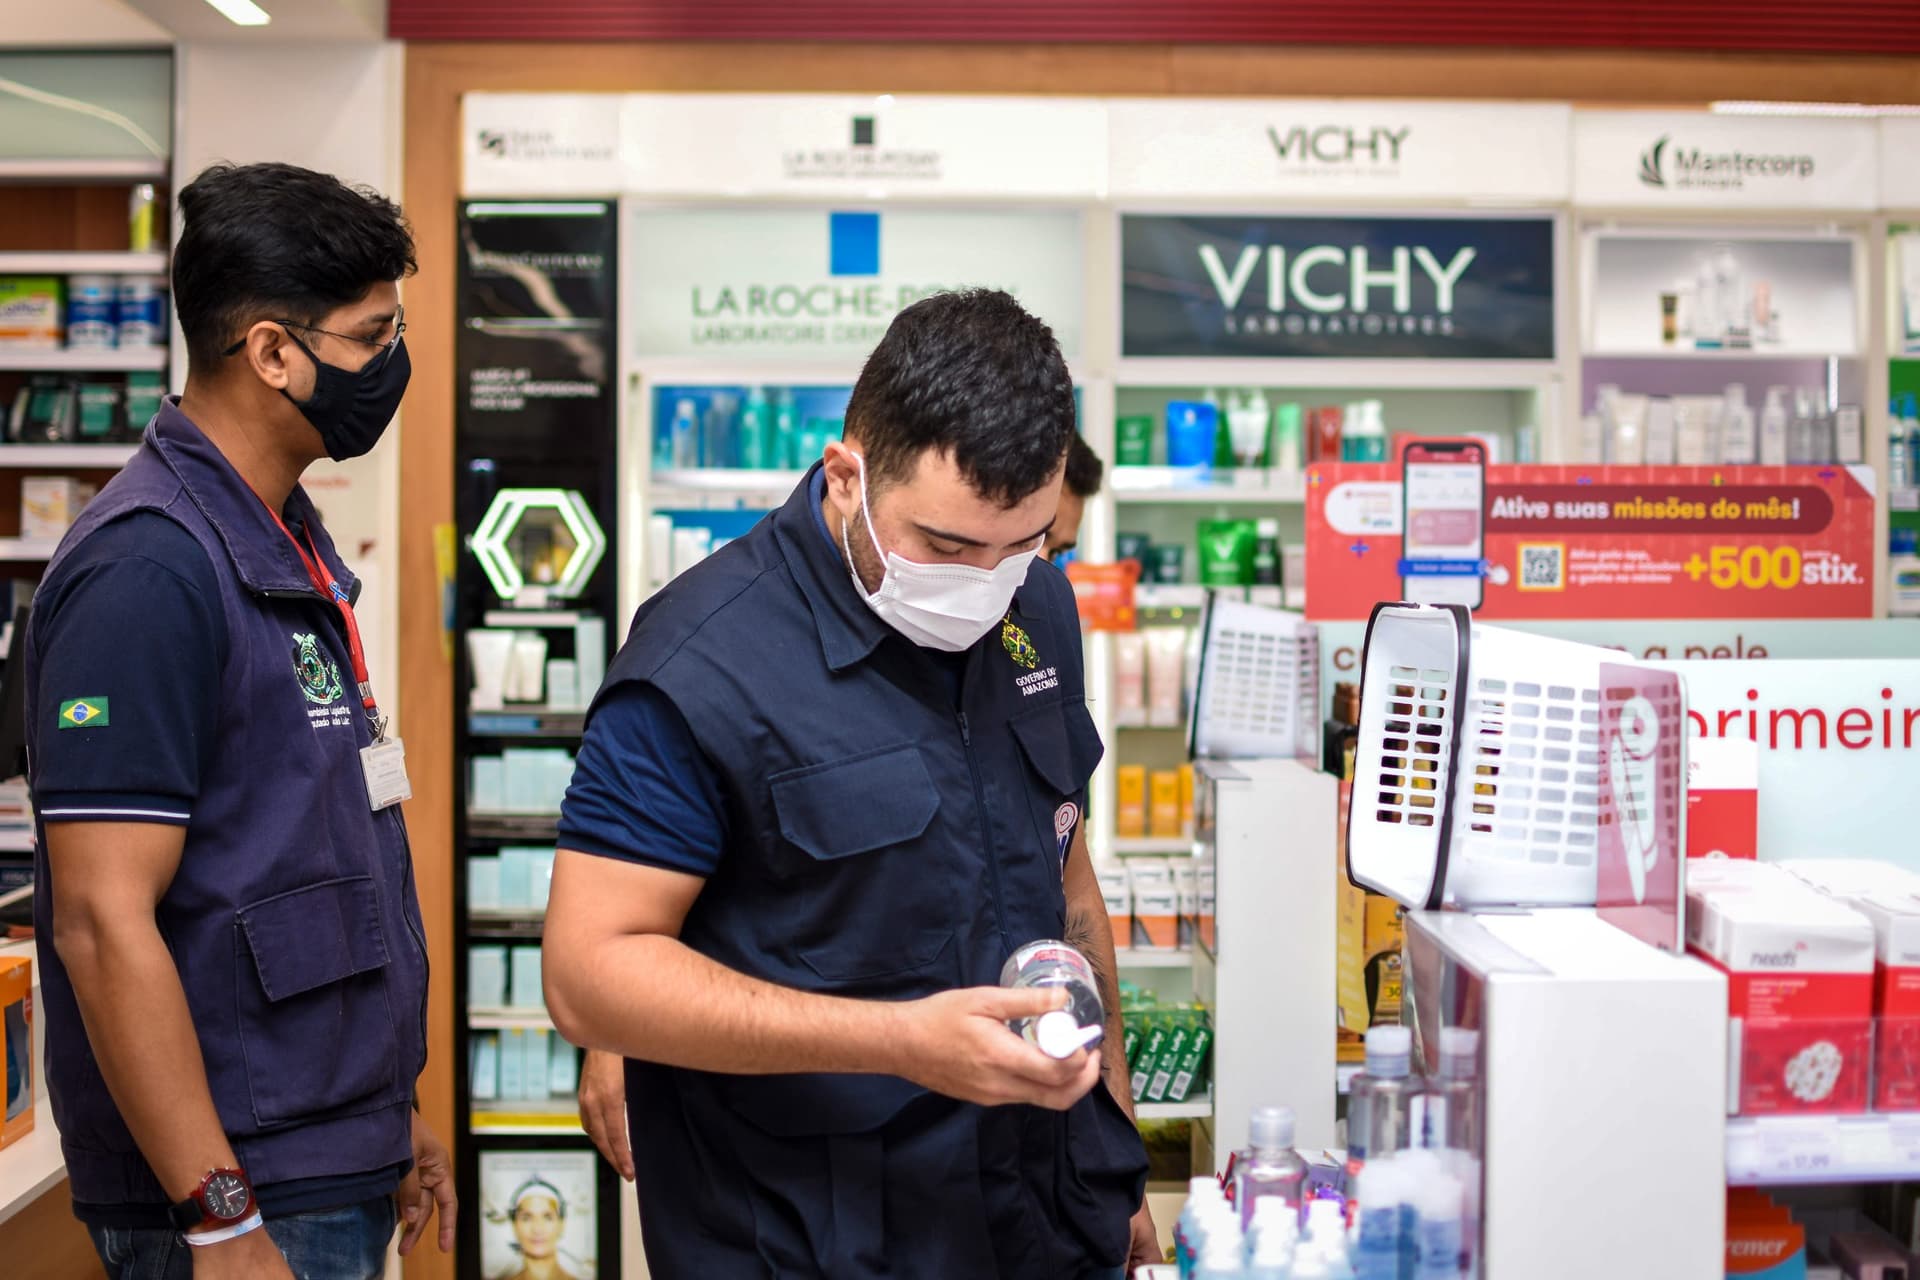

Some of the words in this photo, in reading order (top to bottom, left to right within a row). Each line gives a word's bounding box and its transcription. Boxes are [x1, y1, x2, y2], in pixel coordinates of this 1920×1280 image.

[1266, 124, 1411, 162] VICHY
[1675, 149, 1815, 178] Mantecorp
[1198, 244, 1478, 313] VICHY
[692, 285, 742, 317] LA
[1491, 495, 1549, 519] Ative
[1553, 502, 1609, 519] suas
[1614, 495, 1706, 519] missões
[1710, 497, 1741, 519] do
[1745, 496, 1800, 520] mês!
[1684, 546, 1801, 589] +500
[1803, 554, 1864, 584] stix.
[1016, 670, 1047, 687] GOVERNO
[1022, 677, 1058, 696] AMAZONAS
